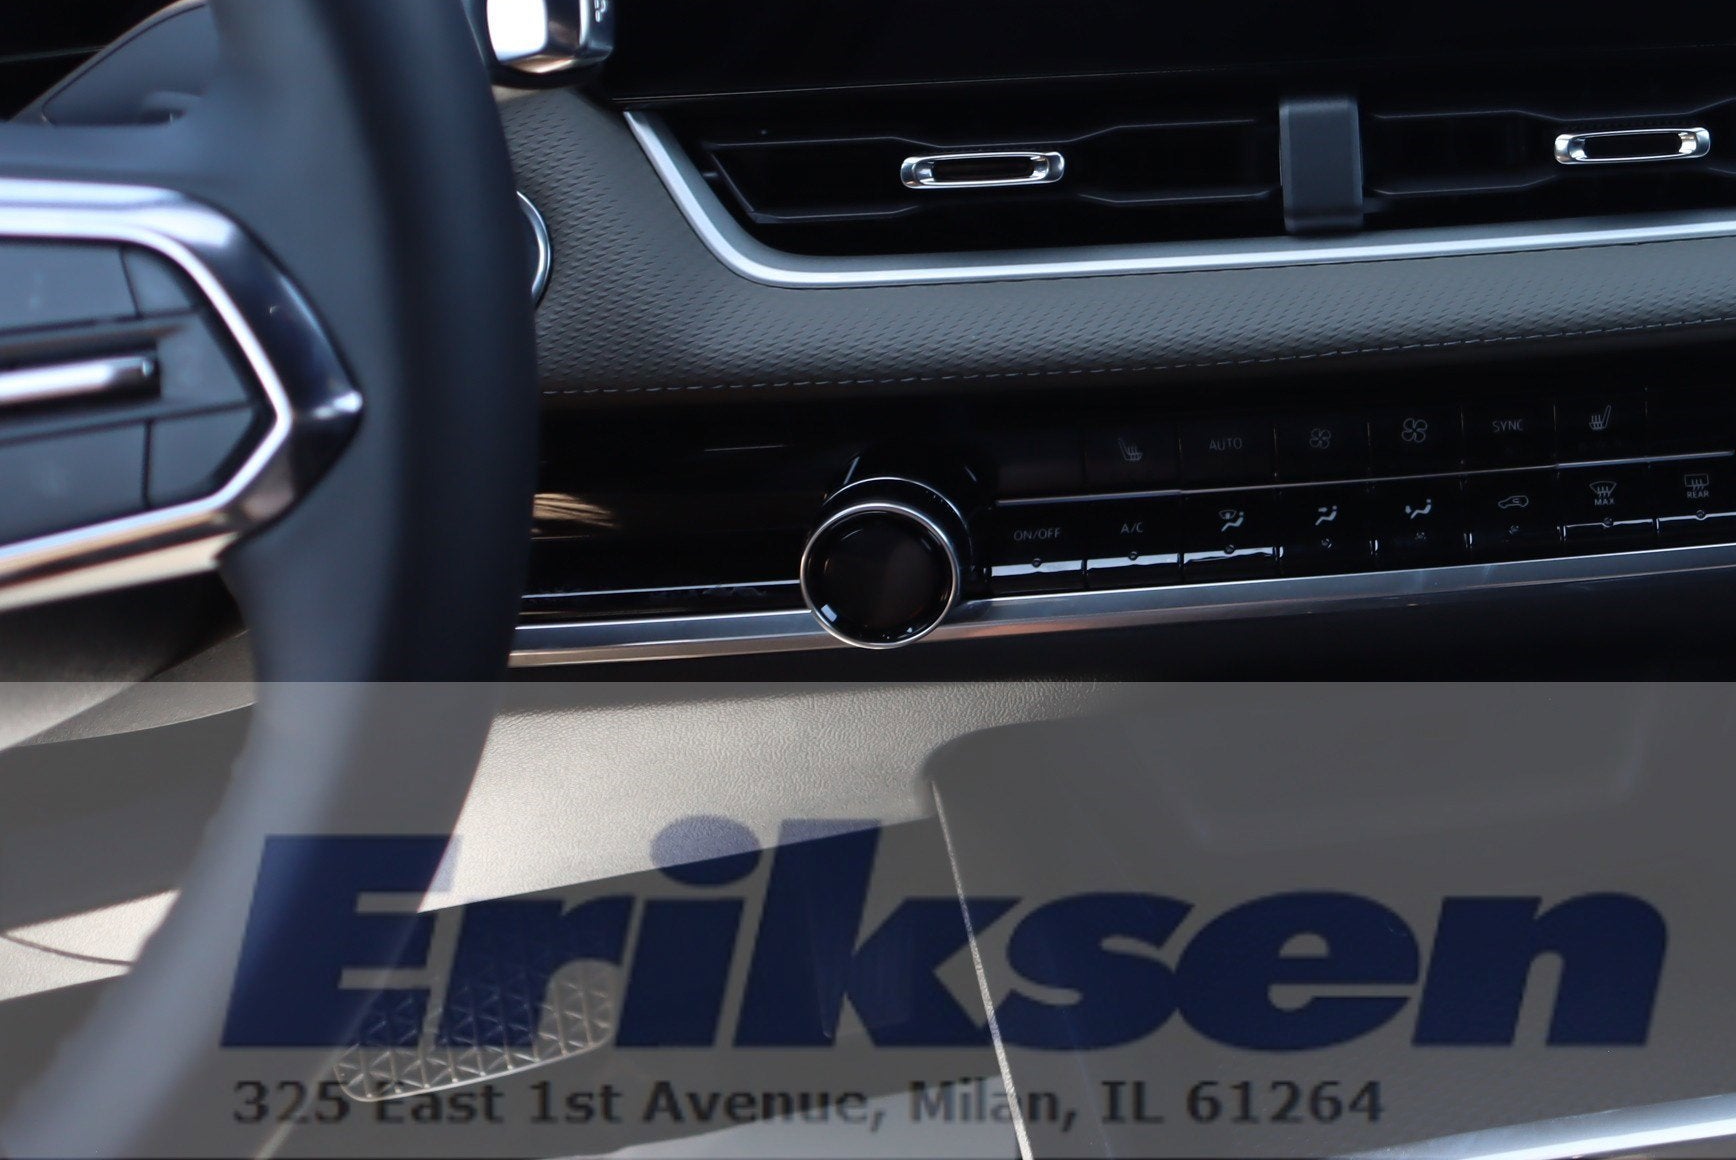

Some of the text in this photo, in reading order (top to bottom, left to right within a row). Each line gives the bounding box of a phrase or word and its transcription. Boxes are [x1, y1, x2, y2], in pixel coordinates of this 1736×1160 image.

[1492, 418, 1523, 433] SYNC
[1208, 436, 1243, 451] AUTO
[1593, 496, 1615, 506] MAX
[1686, 488, 1710, 500] REAR
[1012, 527, 1062, 542] ON/OFF
[1120, 520, 1144, 535] A/C
